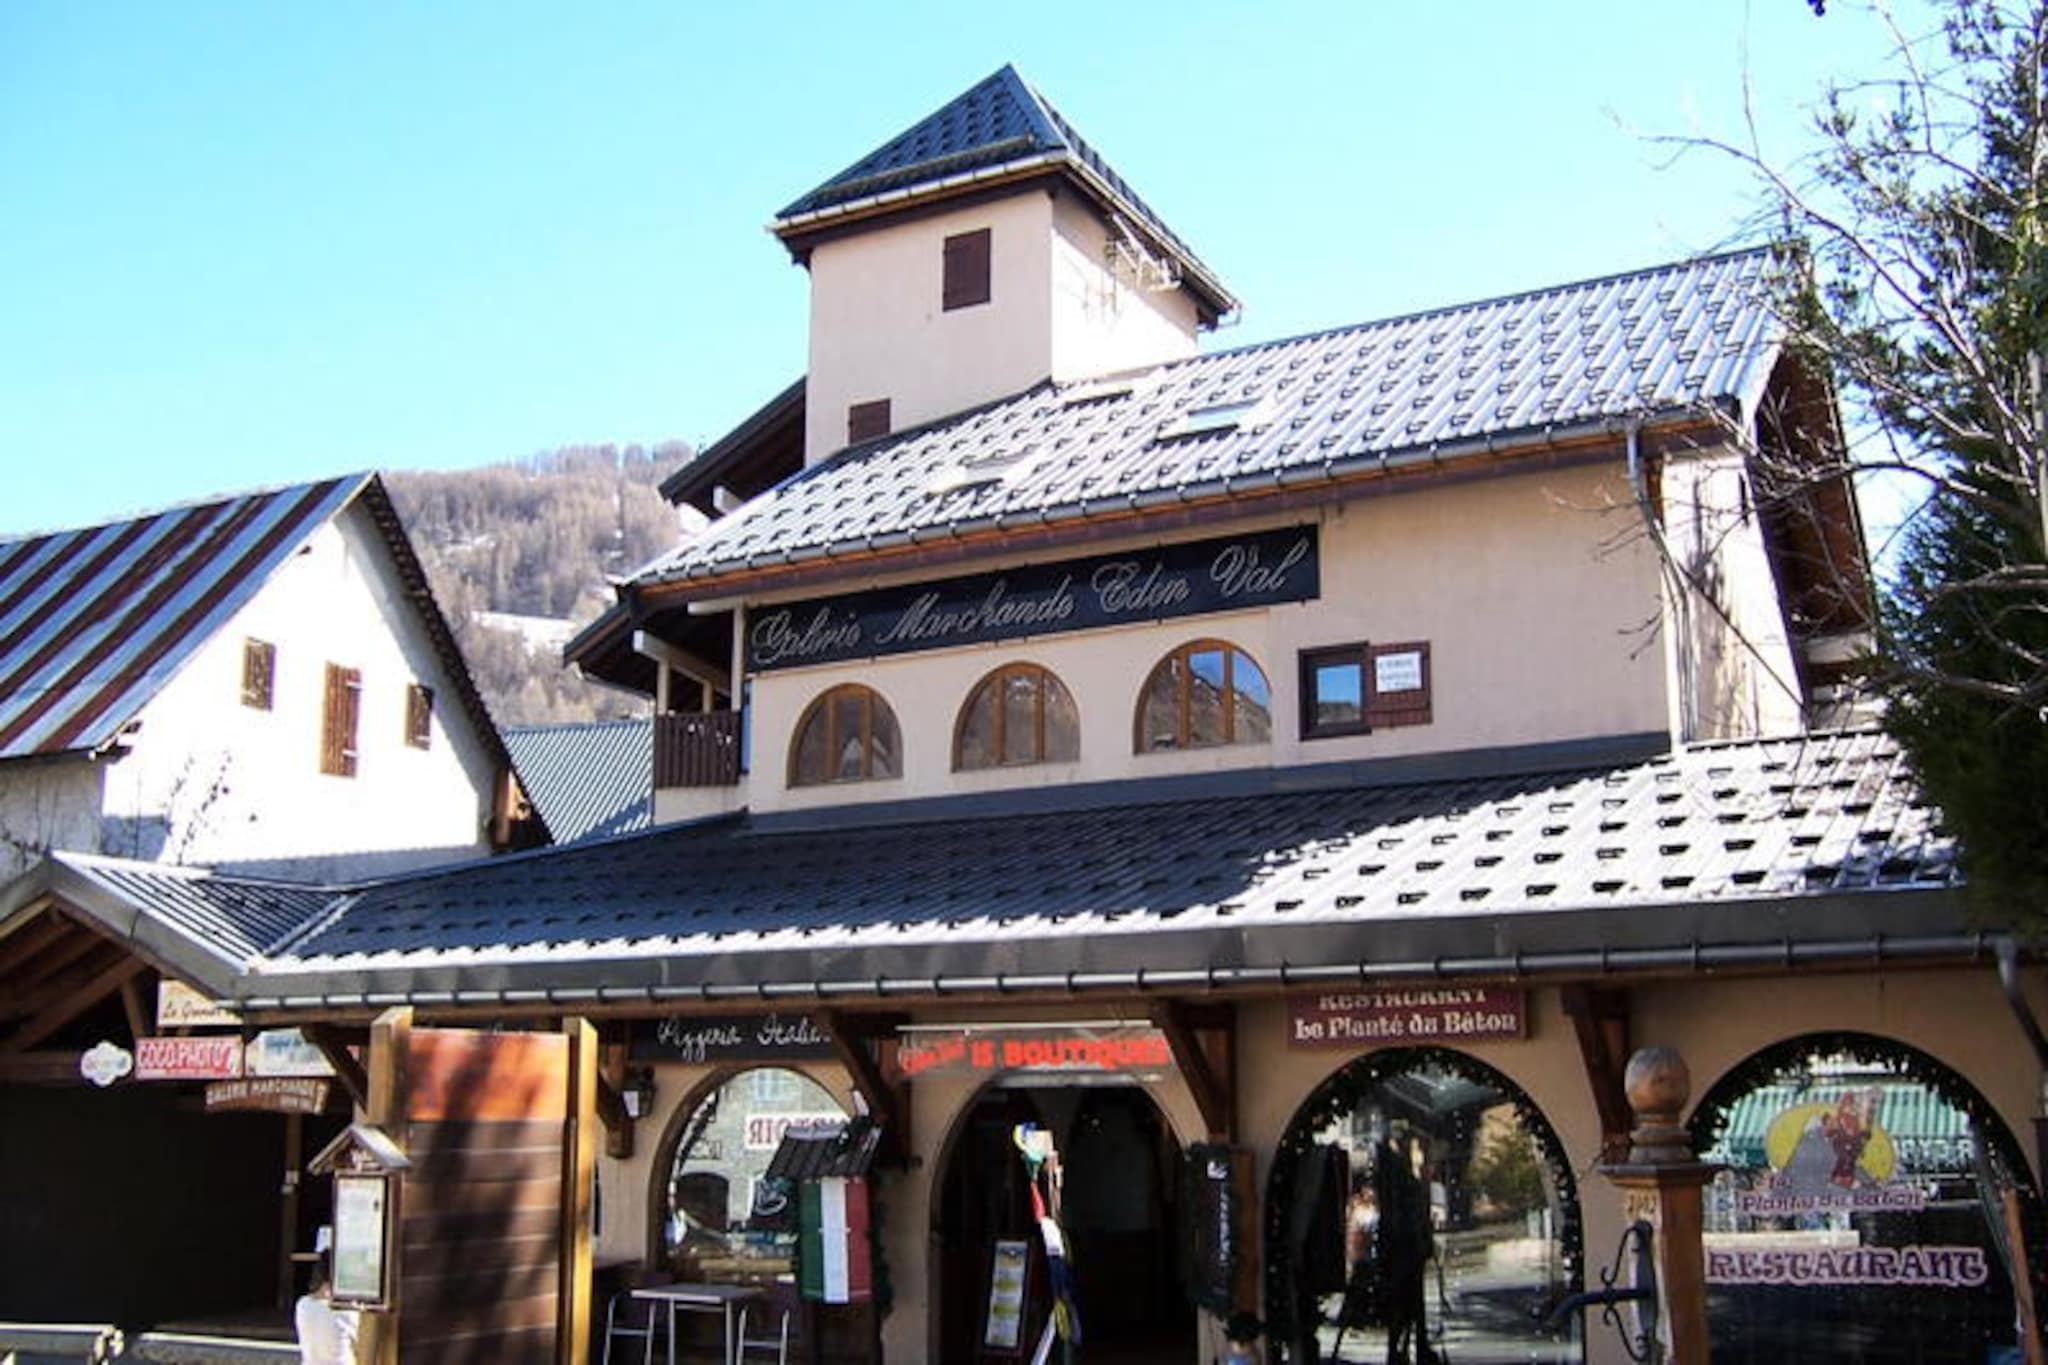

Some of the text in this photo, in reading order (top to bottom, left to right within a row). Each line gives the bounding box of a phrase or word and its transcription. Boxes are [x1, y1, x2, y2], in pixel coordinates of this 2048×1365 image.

[1092, 562, 1191, 613] Eden
[1210, 536, 1310, 597] Val
[1295, 1010, 1516, 1039] Le Planté du Bâton
[1003, 1037, 1169, 1070] BOUTIQUES
[1706, 1248, 1986, 1284] RESTAURANT
